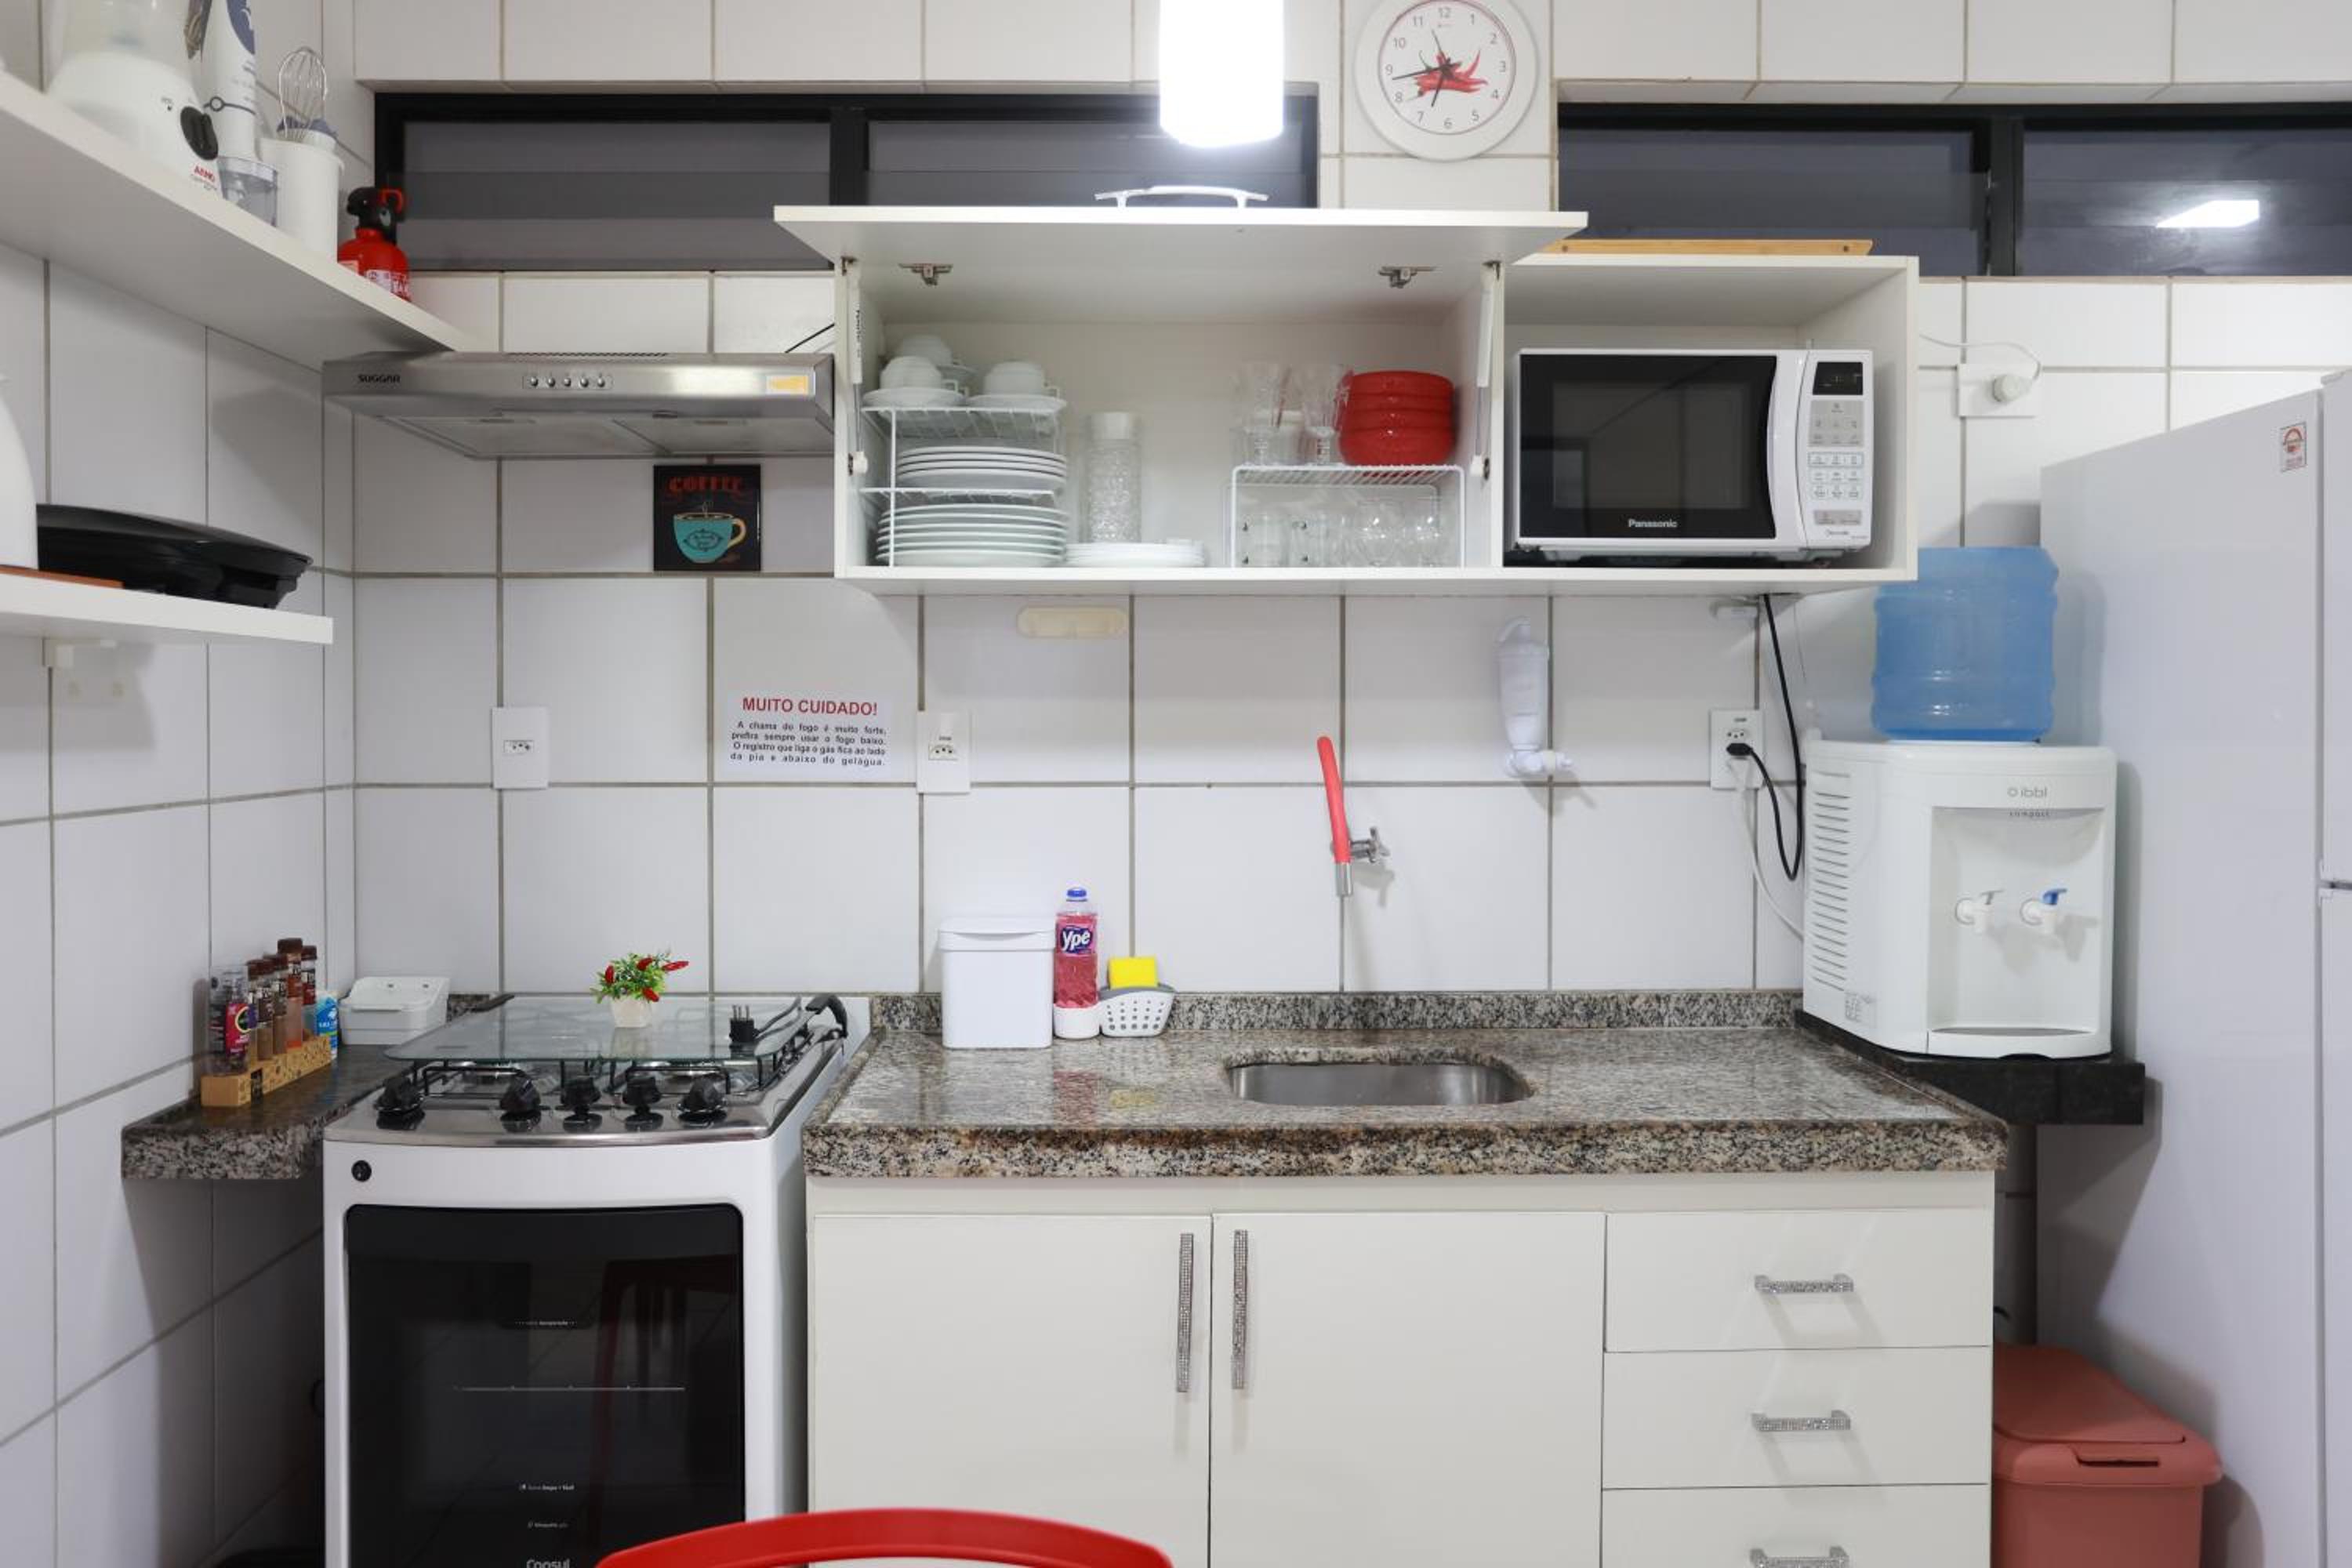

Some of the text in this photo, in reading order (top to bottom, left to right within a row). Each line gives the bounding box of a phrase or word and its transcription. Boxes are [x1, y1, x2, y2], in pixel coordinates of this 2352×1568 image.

[1438, 7, 1450, 18] 12
[1413, 16, 1423, 26] 11
[1393, 37, 1406, 49] 10
[1490, 33, 1497, 44] 2
[1385, 64, 1393, 75] 9
[1499, 60, 1507, 72] 3
[1395, 92, 1403, 103] 8
[1491, 89, 1499, 99] 4
[1417, 111, 1425, 122] 7
[1472, 110, 1479, 121] 5
[1443, 118, 1452, 129] 6
[358, 373, 401, 383] SUGGAR
[1628, 518, 1677, 528] Panasonic
[742, 696, 877, 716] MUITO CUIDADO!
[799, 723, 818, 733] fogo
[834, 725, 859, 734] muito
[731, 731, 758, 740] prefira
[835, 735, 855, 746] fogo
[742, 742, 775, 752] registro
[794, 744, 810, 754] liga
[837, 746, 853, 754] fica
[866, 746, 886, 755] lado
[749, 753, 764, 762] pia
[783, 754, 816, 763] abaixo
[822, 755, 835, 764] do
